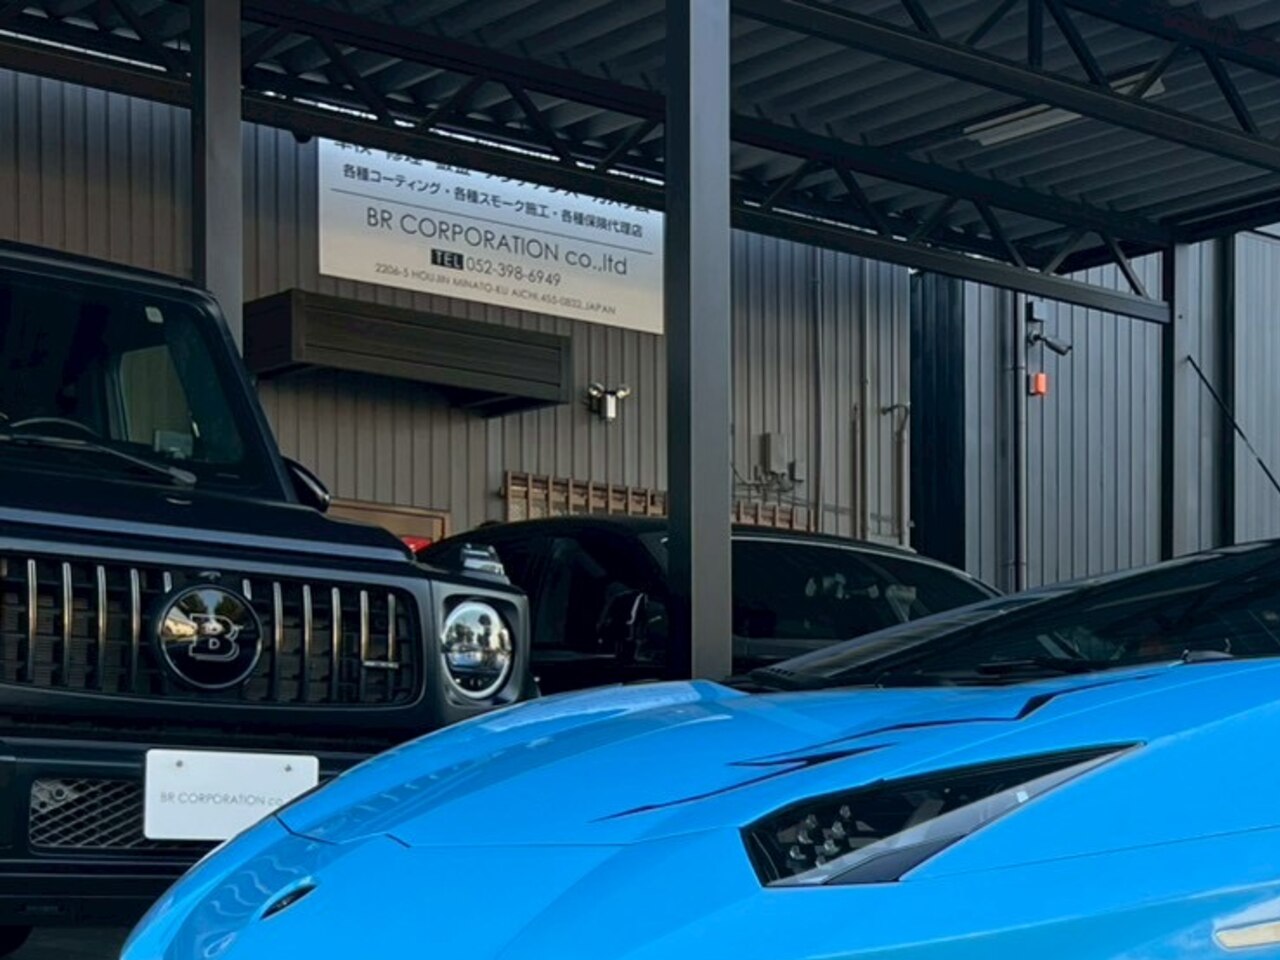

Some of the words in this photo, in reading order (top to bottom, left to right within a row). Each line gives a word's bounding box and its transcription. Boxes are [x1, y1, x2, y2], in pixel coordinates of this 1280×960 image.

[367, 206, 393, 231] BR
[400, 213, 559, 262] CORPORATION
[565, 250, 628, 276] co.,ltd
[433, 250, 462, 269] TEL
[465, 256, 561, 287] 052-398-6949
[159, 791, 175, 805] BR
[178, 791, 266, 806] CORPORATION
